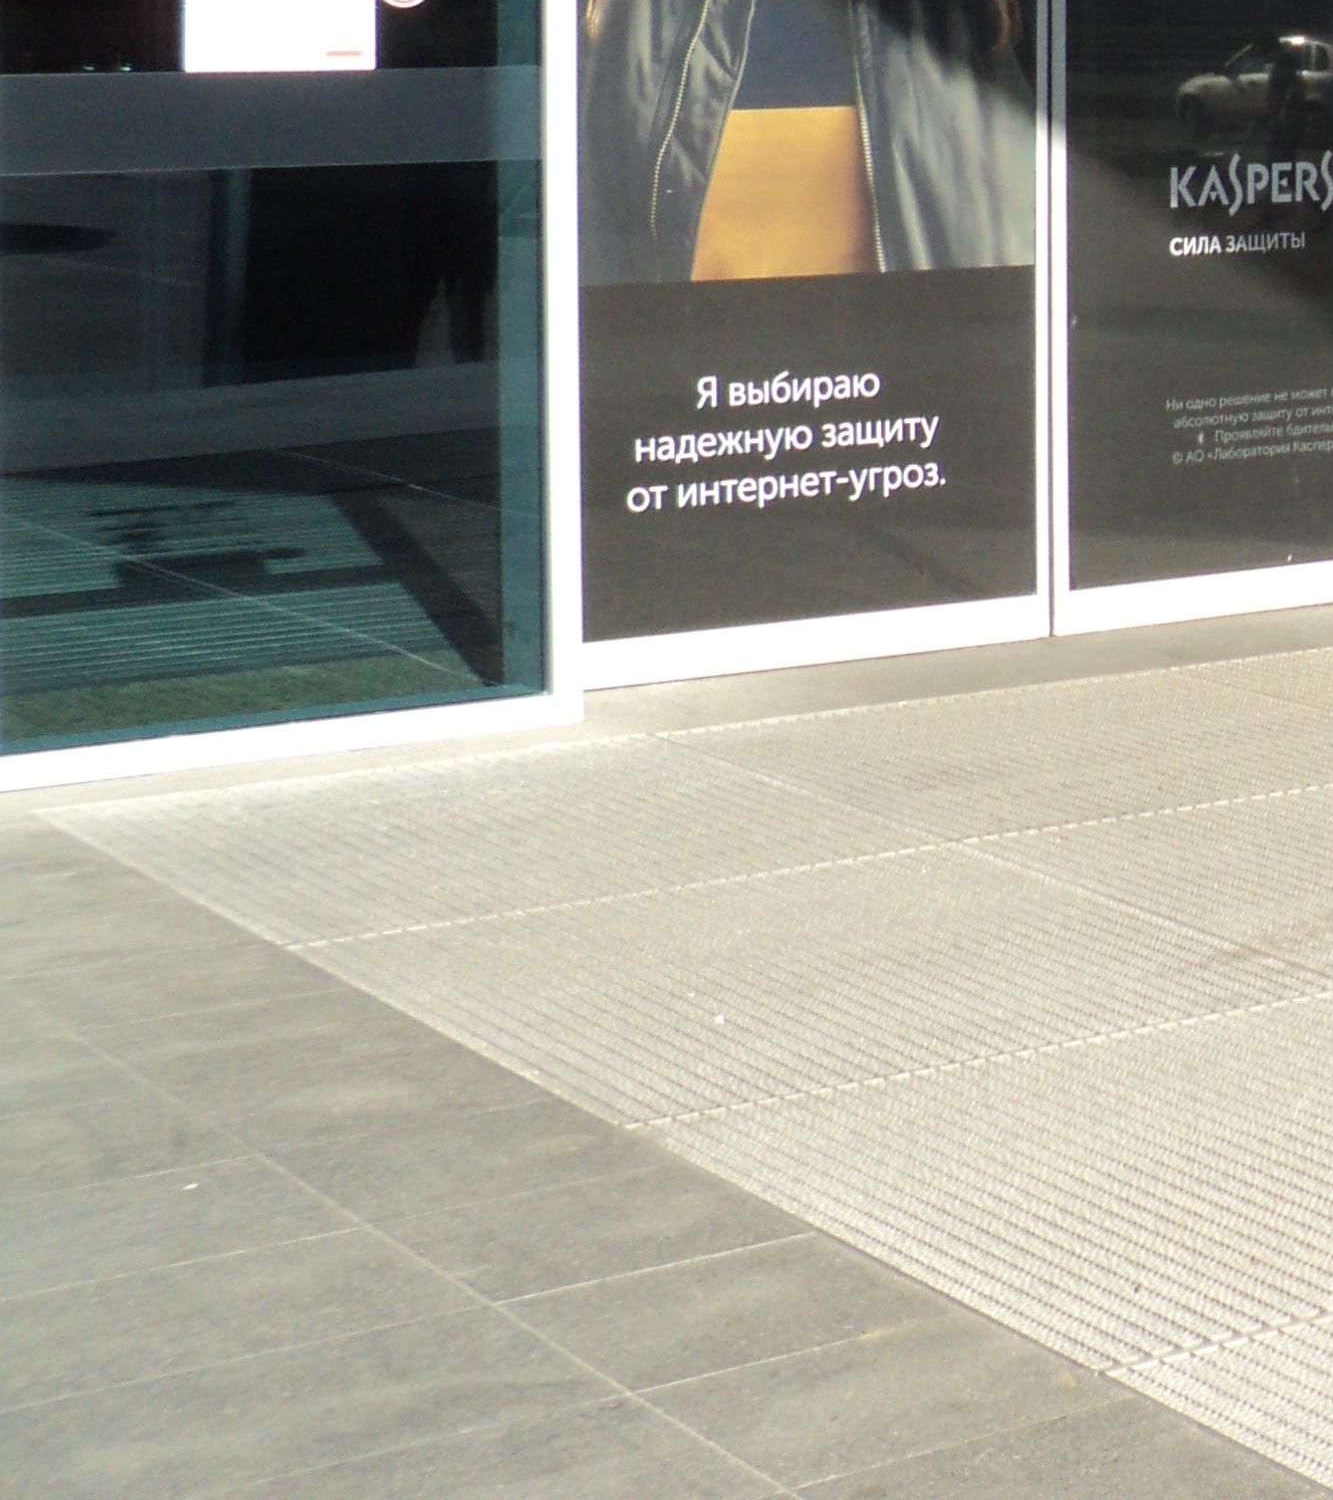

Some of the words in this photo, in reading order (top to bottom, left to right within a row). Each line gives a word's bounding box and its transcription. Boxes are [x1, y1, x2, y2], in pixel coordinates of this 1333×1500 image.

[1169, 236, 1223, 256] СИЛА
[1225, 231, 1306, 253] ЗАЩИТЫ
[696, 375, 717, 409] Я
[729, 371, 881, 407] выбираю
[1186, 398, 1216, 410] одно
[1219, 392, 1271, 409] решение
[1291, 388, 1327, 400] может
[634, 423, 812, 464] надежную
[822, 415, 939, 448] защиту
[626, 484, 668, 512] от
[677, 461, 946, 508] интернет-угроз.
